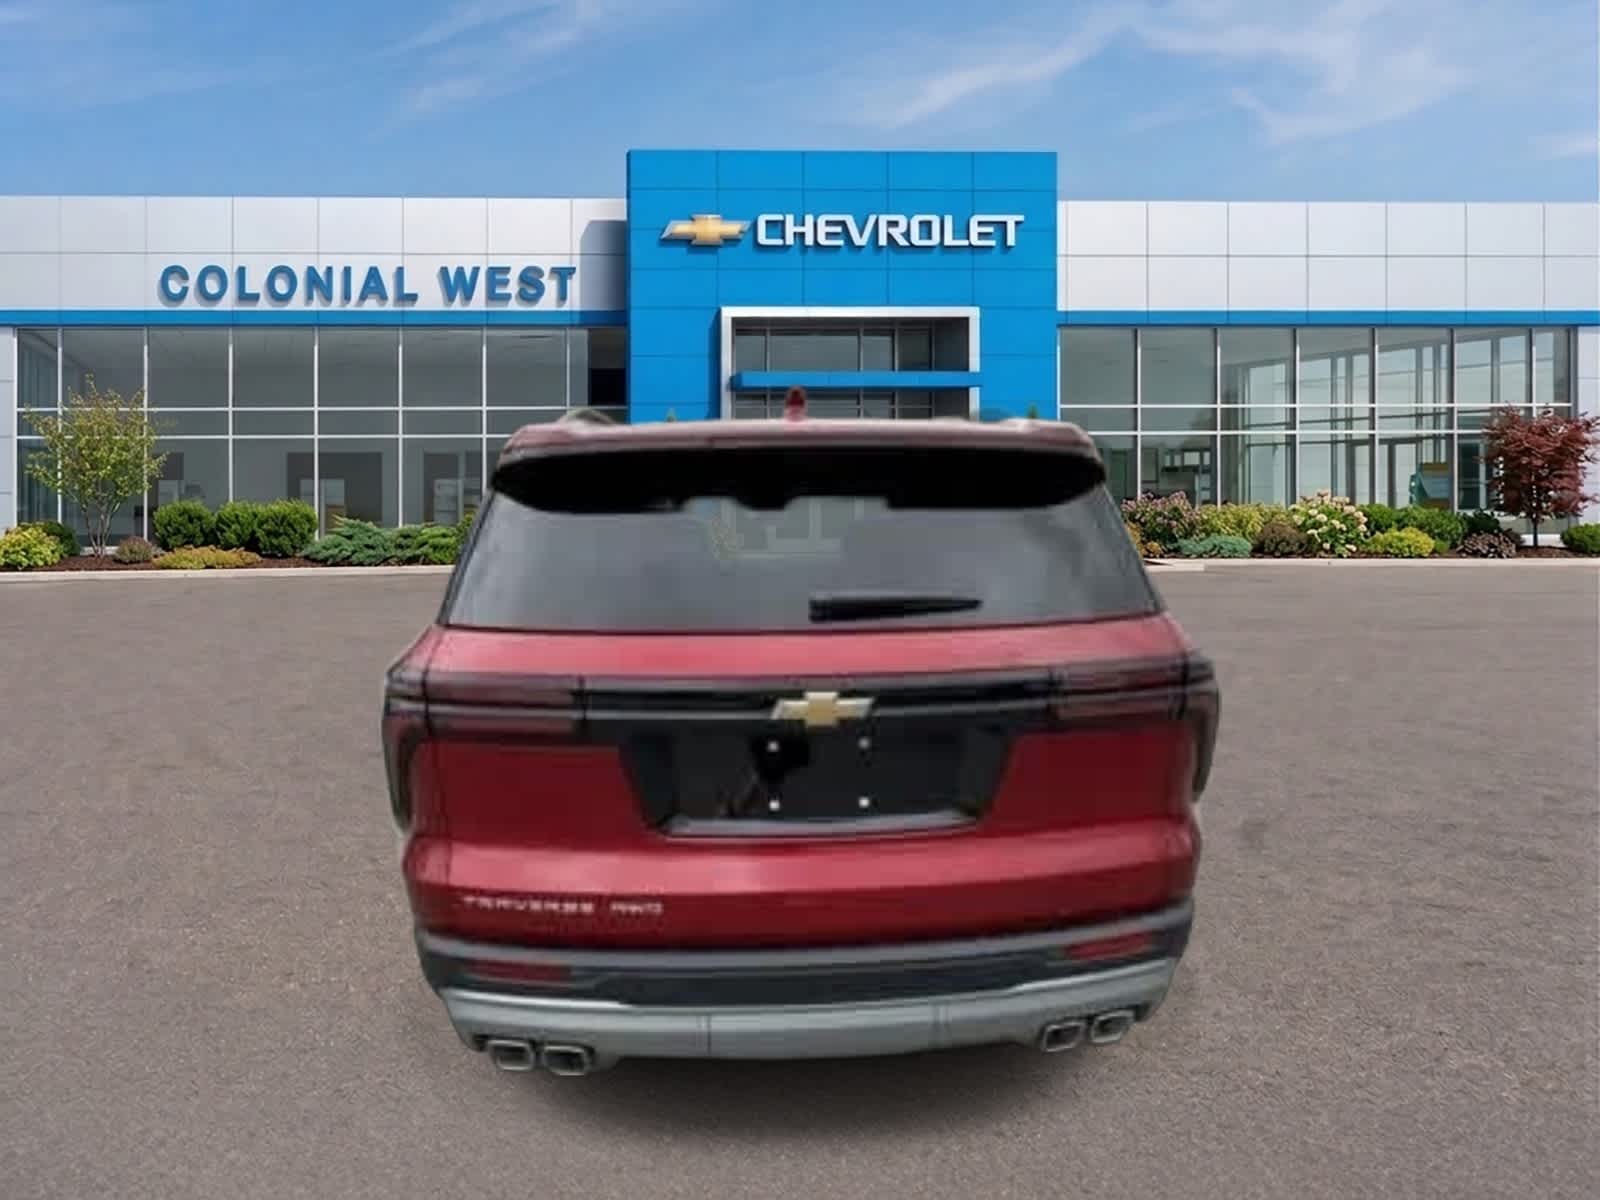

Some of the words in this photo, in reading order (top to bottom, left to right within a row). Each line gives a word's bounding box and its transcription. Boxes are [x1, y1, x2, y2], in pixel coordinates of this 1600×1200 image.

[756, 213, 1025, 248] CHEVROLET
[159, 264, 419, 303] COLONIAL
[438, 265, 577, 303] WEST
